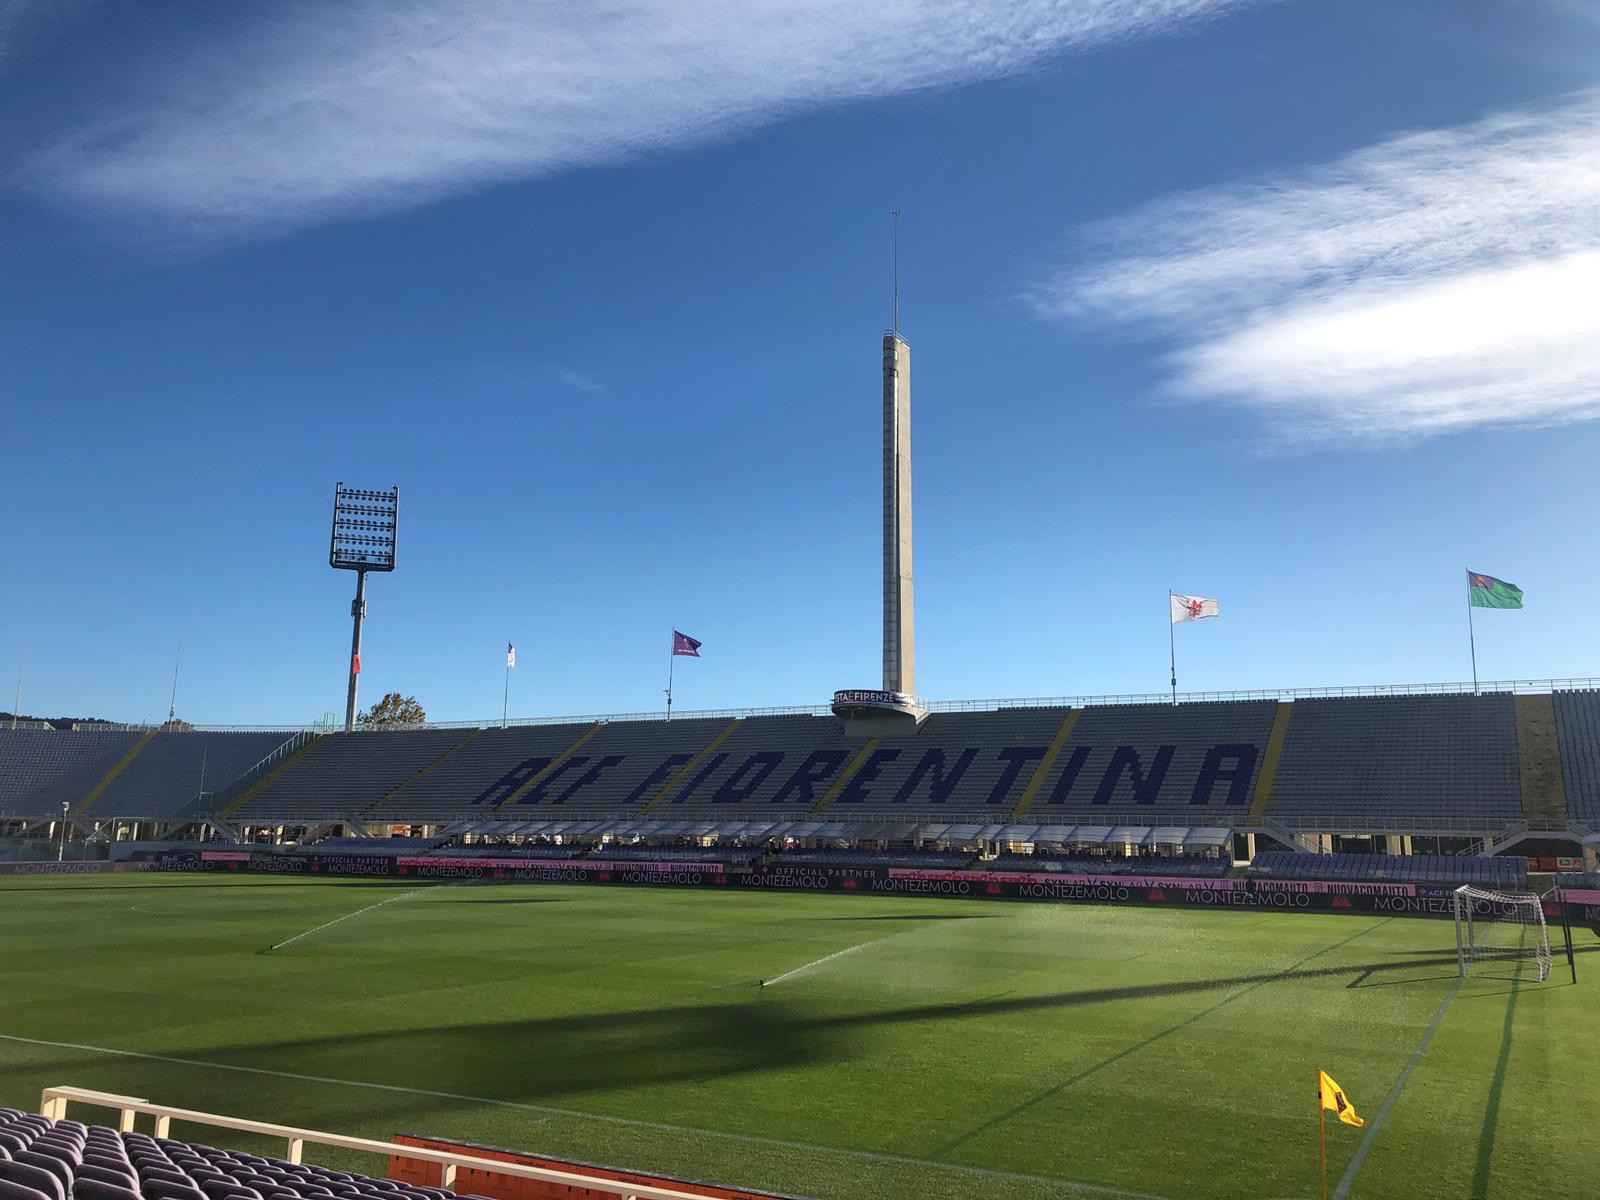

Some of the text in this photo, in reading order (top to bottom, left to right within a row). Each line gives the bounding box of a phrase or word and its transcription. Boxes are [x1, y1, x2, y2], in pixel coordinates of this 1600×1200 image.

[471, 743, 1261, 805] ACF FIORENTINA
[15, 863, 101, 873] MONTEZEMOLO
[138, 861, 215, 872] MONTEZEMOLO
[248, 861, 303, 872] MONTEZEMOLO
[328, 863, 389, 875] MONTEZEMOLO
[417, 866, 483, 878] MONTEZEMOLO
[776, 867, 876, 878] OFFICIAL PARTNER
[515, 869, 587, 881] MONTEZEMOLO
[622, 871, 702, 885] MONTEZEMOLO
[741, 873, 829, 889] MONTEZEMOLO
[871, 878, 970, 894] MONTEZEMOLO
[1020, 884, 1130, 900] MONTEZEMOLO
